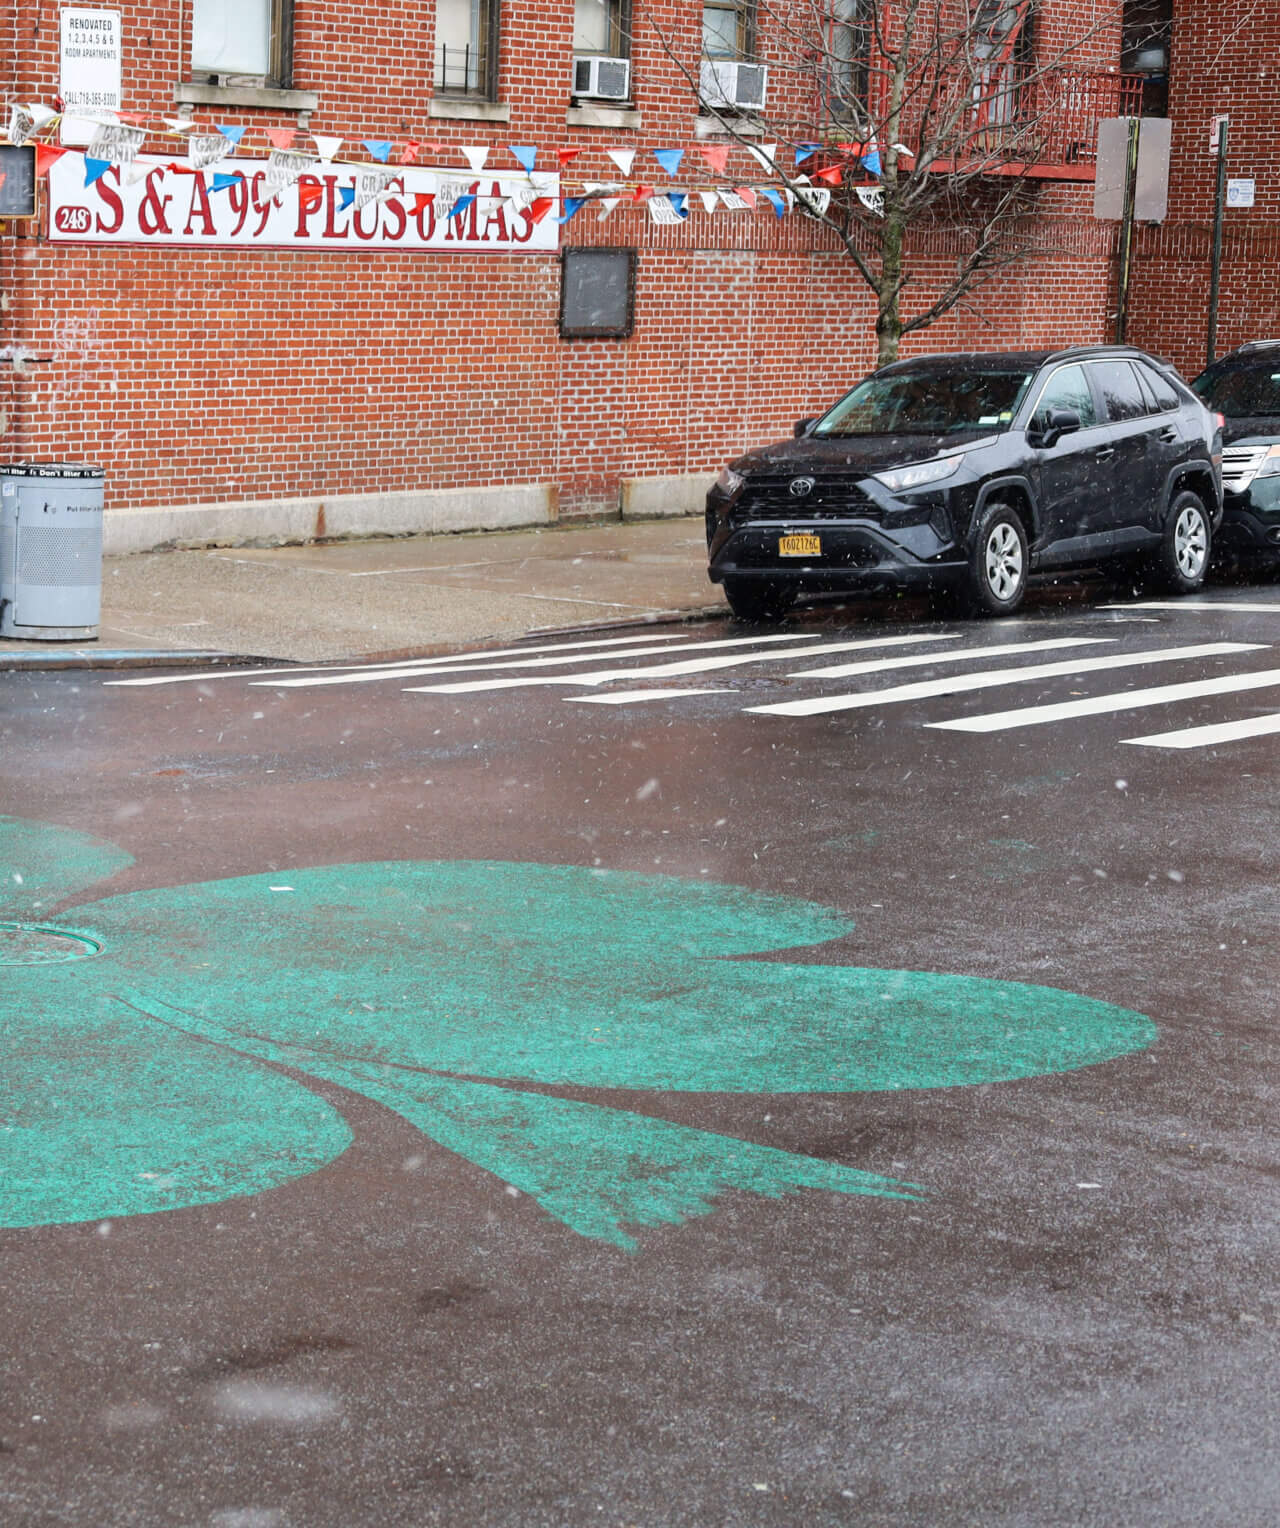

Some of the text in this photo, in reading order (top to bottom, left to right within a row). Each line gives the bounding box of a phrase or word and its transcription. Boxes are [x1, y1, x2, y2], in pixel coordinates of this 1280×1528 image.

[69, 18, 113, 31] RENOVATED
[109, 34, 114, 45] 6
[65, 48, 117, 59] ROOM APARTMENTS
[95, 164, 125, 234] S
[137, 167, 173, 236] &
[182, 170, 218, 236] A
[294, 174, 407, 241] PLUS
[444, 181, 533, 243] MAS
